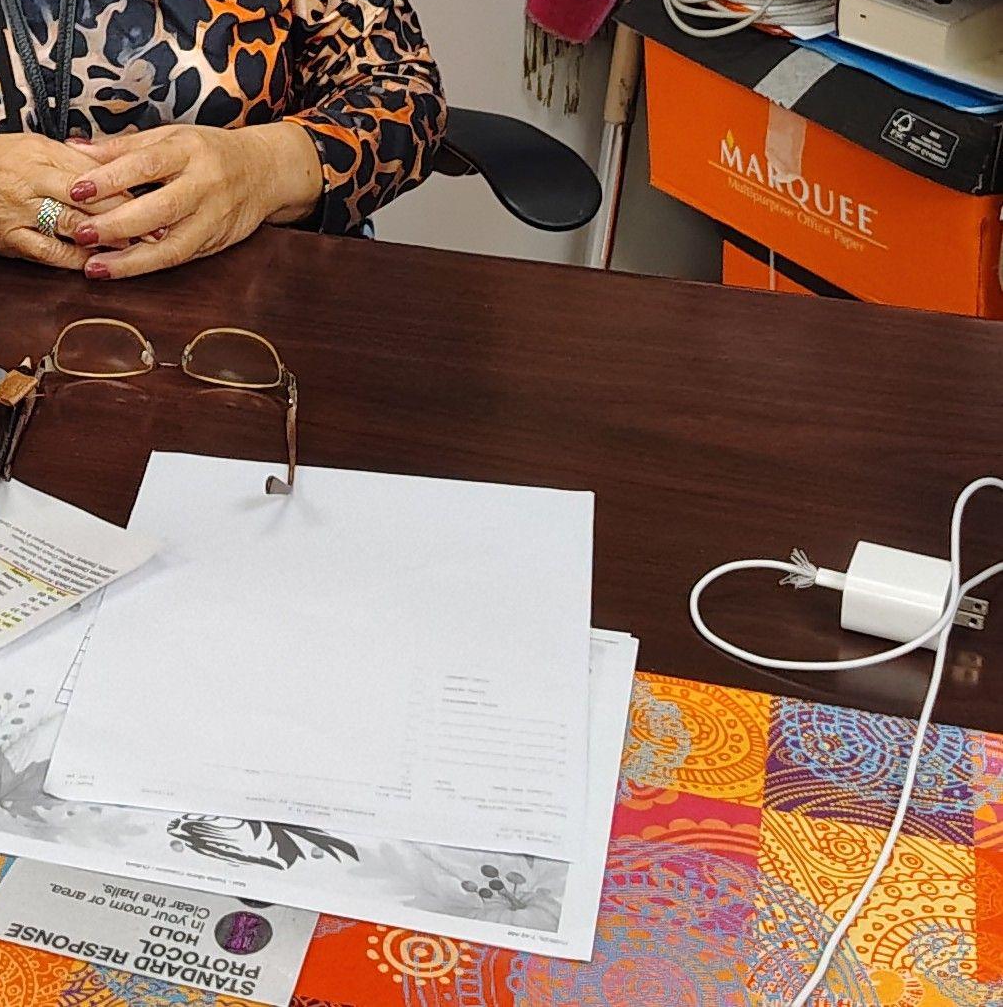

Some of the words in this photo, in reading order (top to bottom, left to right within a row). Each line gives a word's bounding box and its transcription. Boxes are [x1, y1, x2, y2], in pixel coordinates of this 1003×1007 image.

[719, 139, 878, 236] MARQUEE
[728, 176, 795, 217] Multipurpose
[793, 210, 832, 237] Office
[834, 228, 865, 252] Paper
[50, 882, 86, 900] area.
[88, 895, 106, 905] or
[102, 883, 140, 902] halls.
[110, 900, 150, 916] room
[142, 894, 166, 908] the
[169, 900, 210, 919] Clear
[151, 910, 188, 926] your
[4, 922, 130, 966] RESPONSE
[150, 925, 200, 946] HOLD
[140, 938, 262, 980] PROTOCOL
[134, 954, 256, 996] STANDARD
